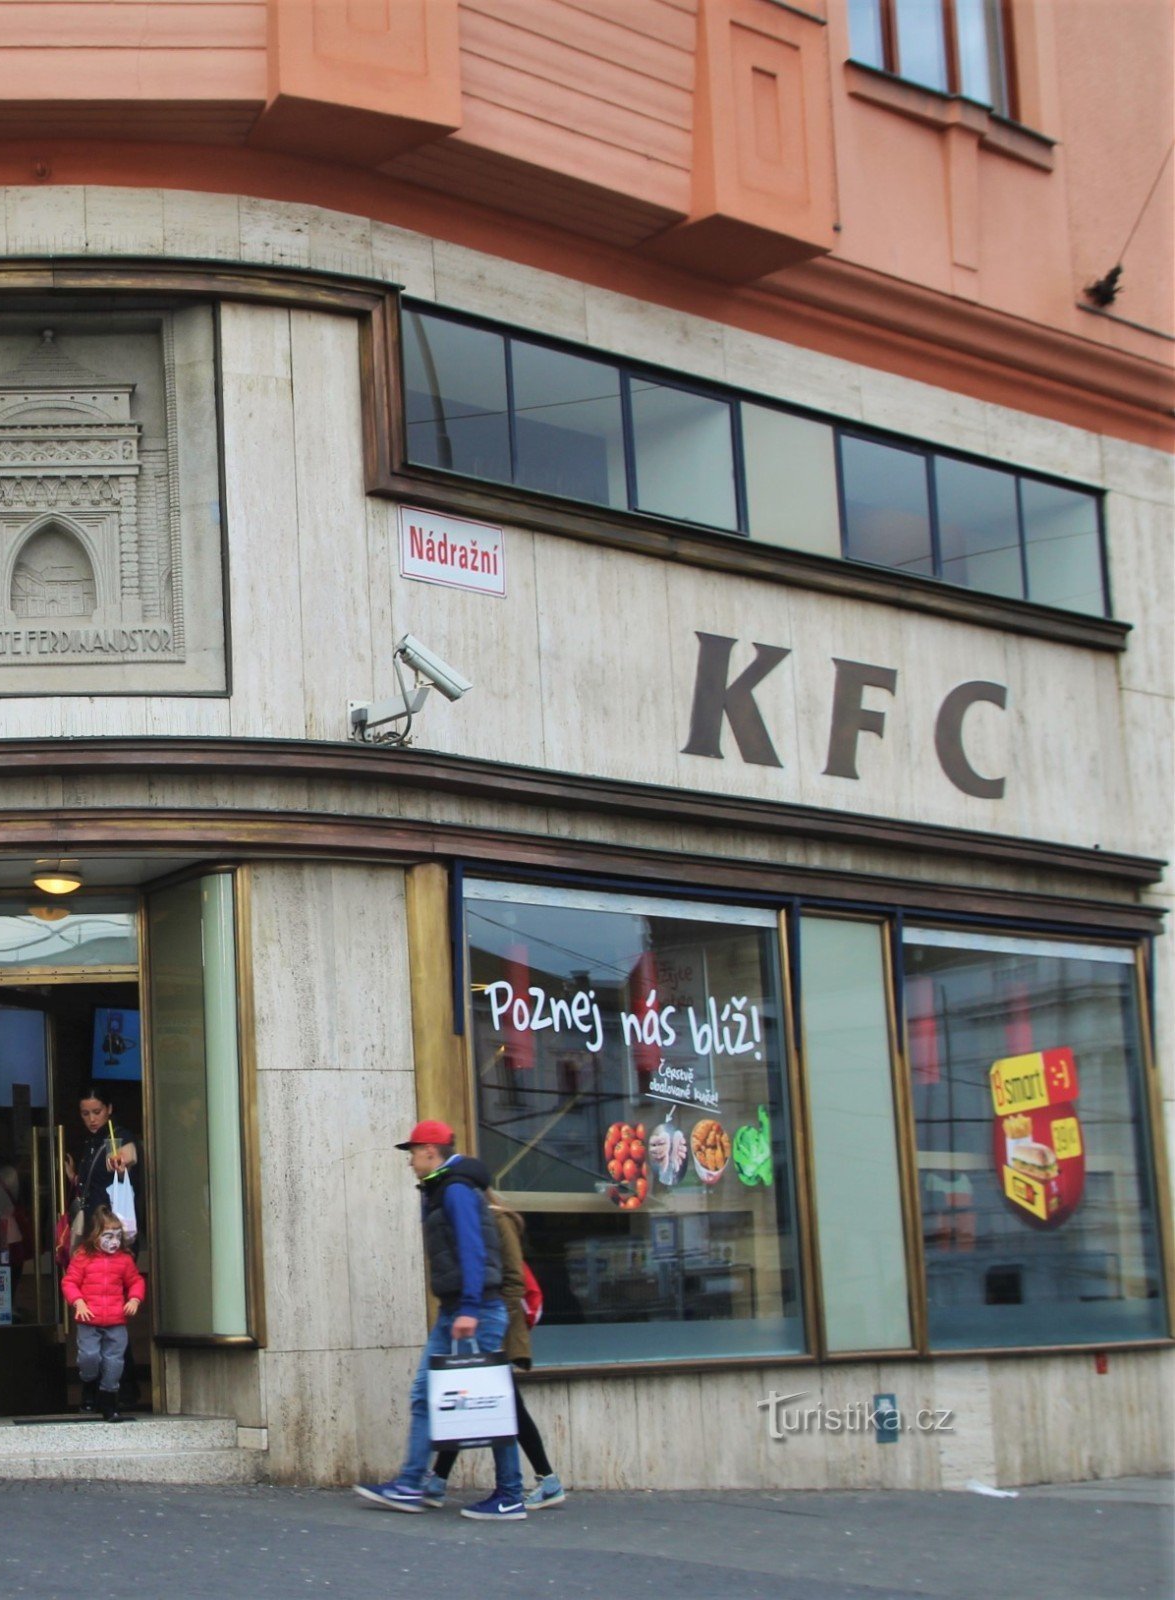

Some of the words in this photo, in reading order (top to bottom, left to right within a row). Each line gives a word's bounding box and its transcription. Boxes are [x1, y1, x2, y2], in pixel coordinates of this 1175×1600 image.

[410, 525, 498, 575] Nádražní
[679, 631, 1007, 800] KFC
[484, 980, 603, 1053] Poznej
[621, 989, 676, 1047] nás
[688, 996, 762, 1061] blíž!
